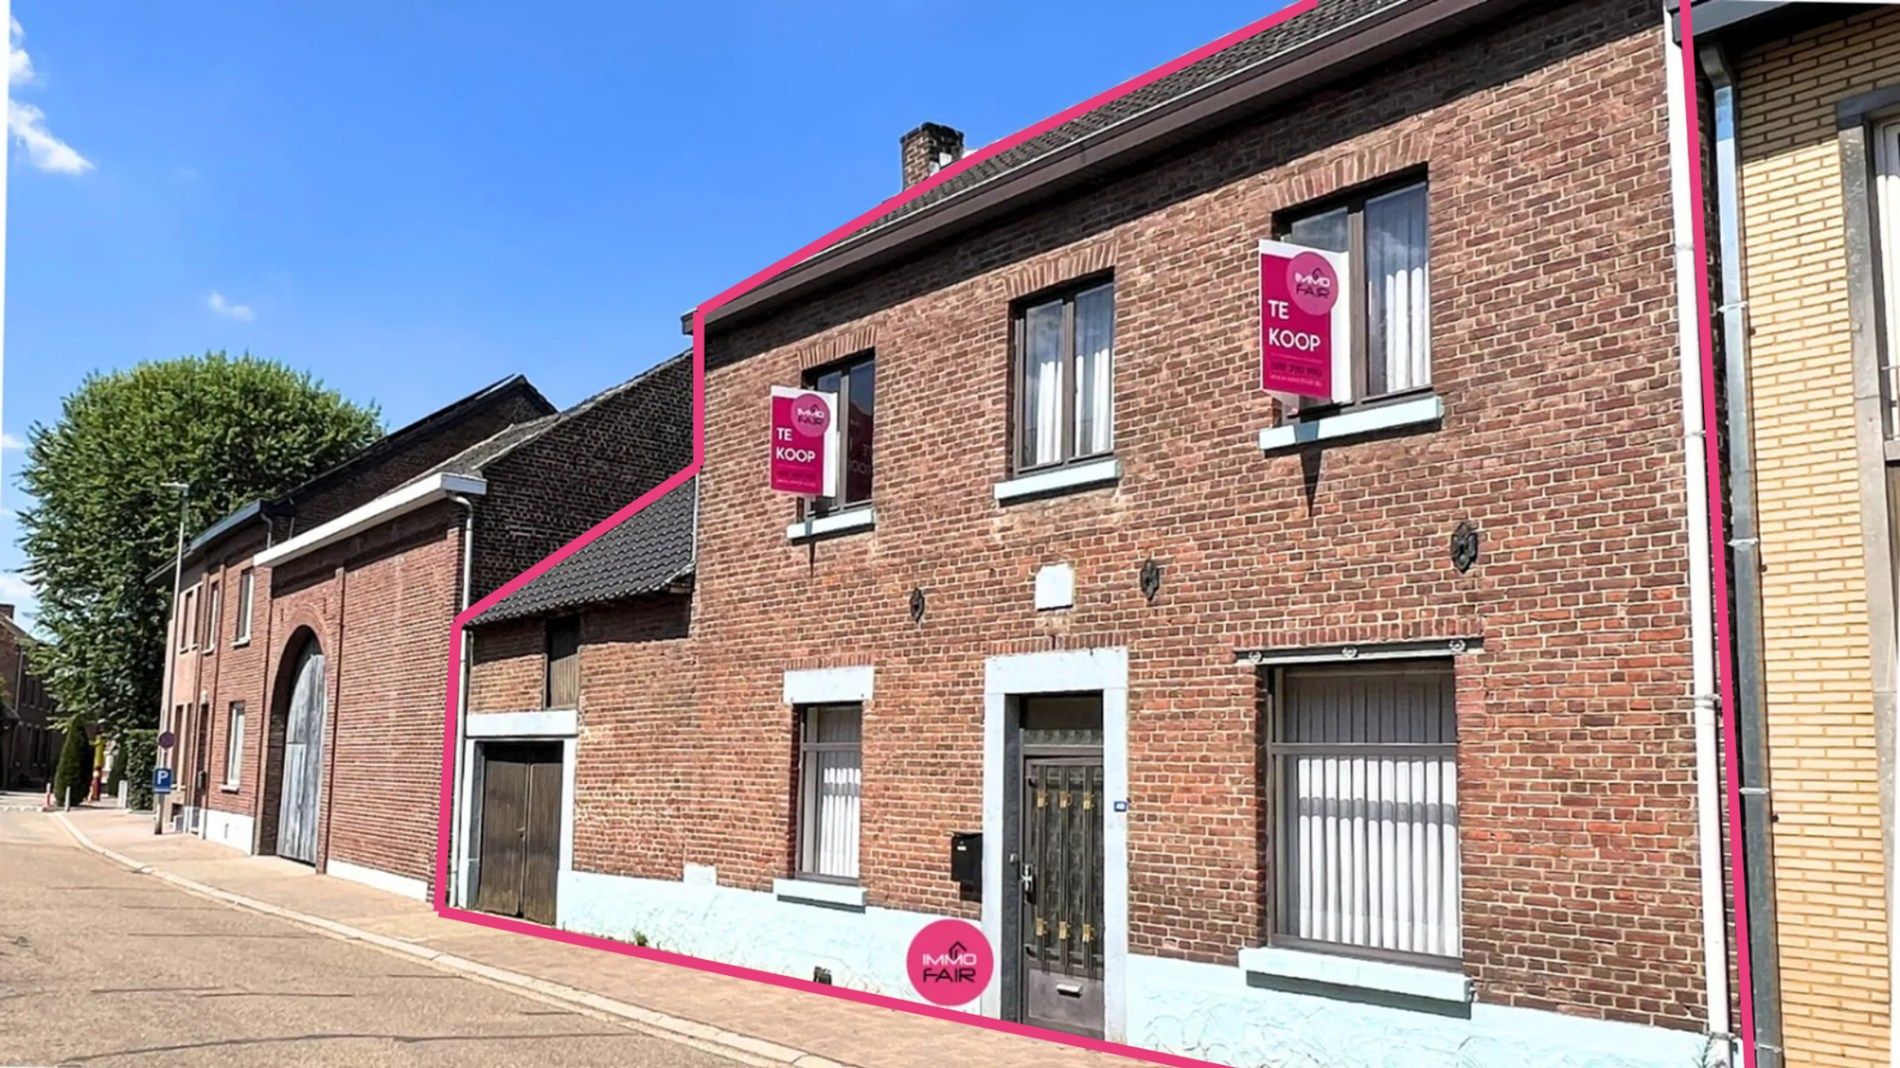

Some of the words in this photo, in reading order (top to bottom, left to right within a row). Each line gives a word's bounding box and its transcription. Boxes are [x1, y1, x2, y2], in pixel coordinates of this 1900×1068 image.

[1267, 300, 1290, 320] TE
[1268, 328, 1321, 352] KOOP
[776, 427, 793, 441] TE
[775, 447, 816, 463] KOOP
[157, 770, 169, 785] P
